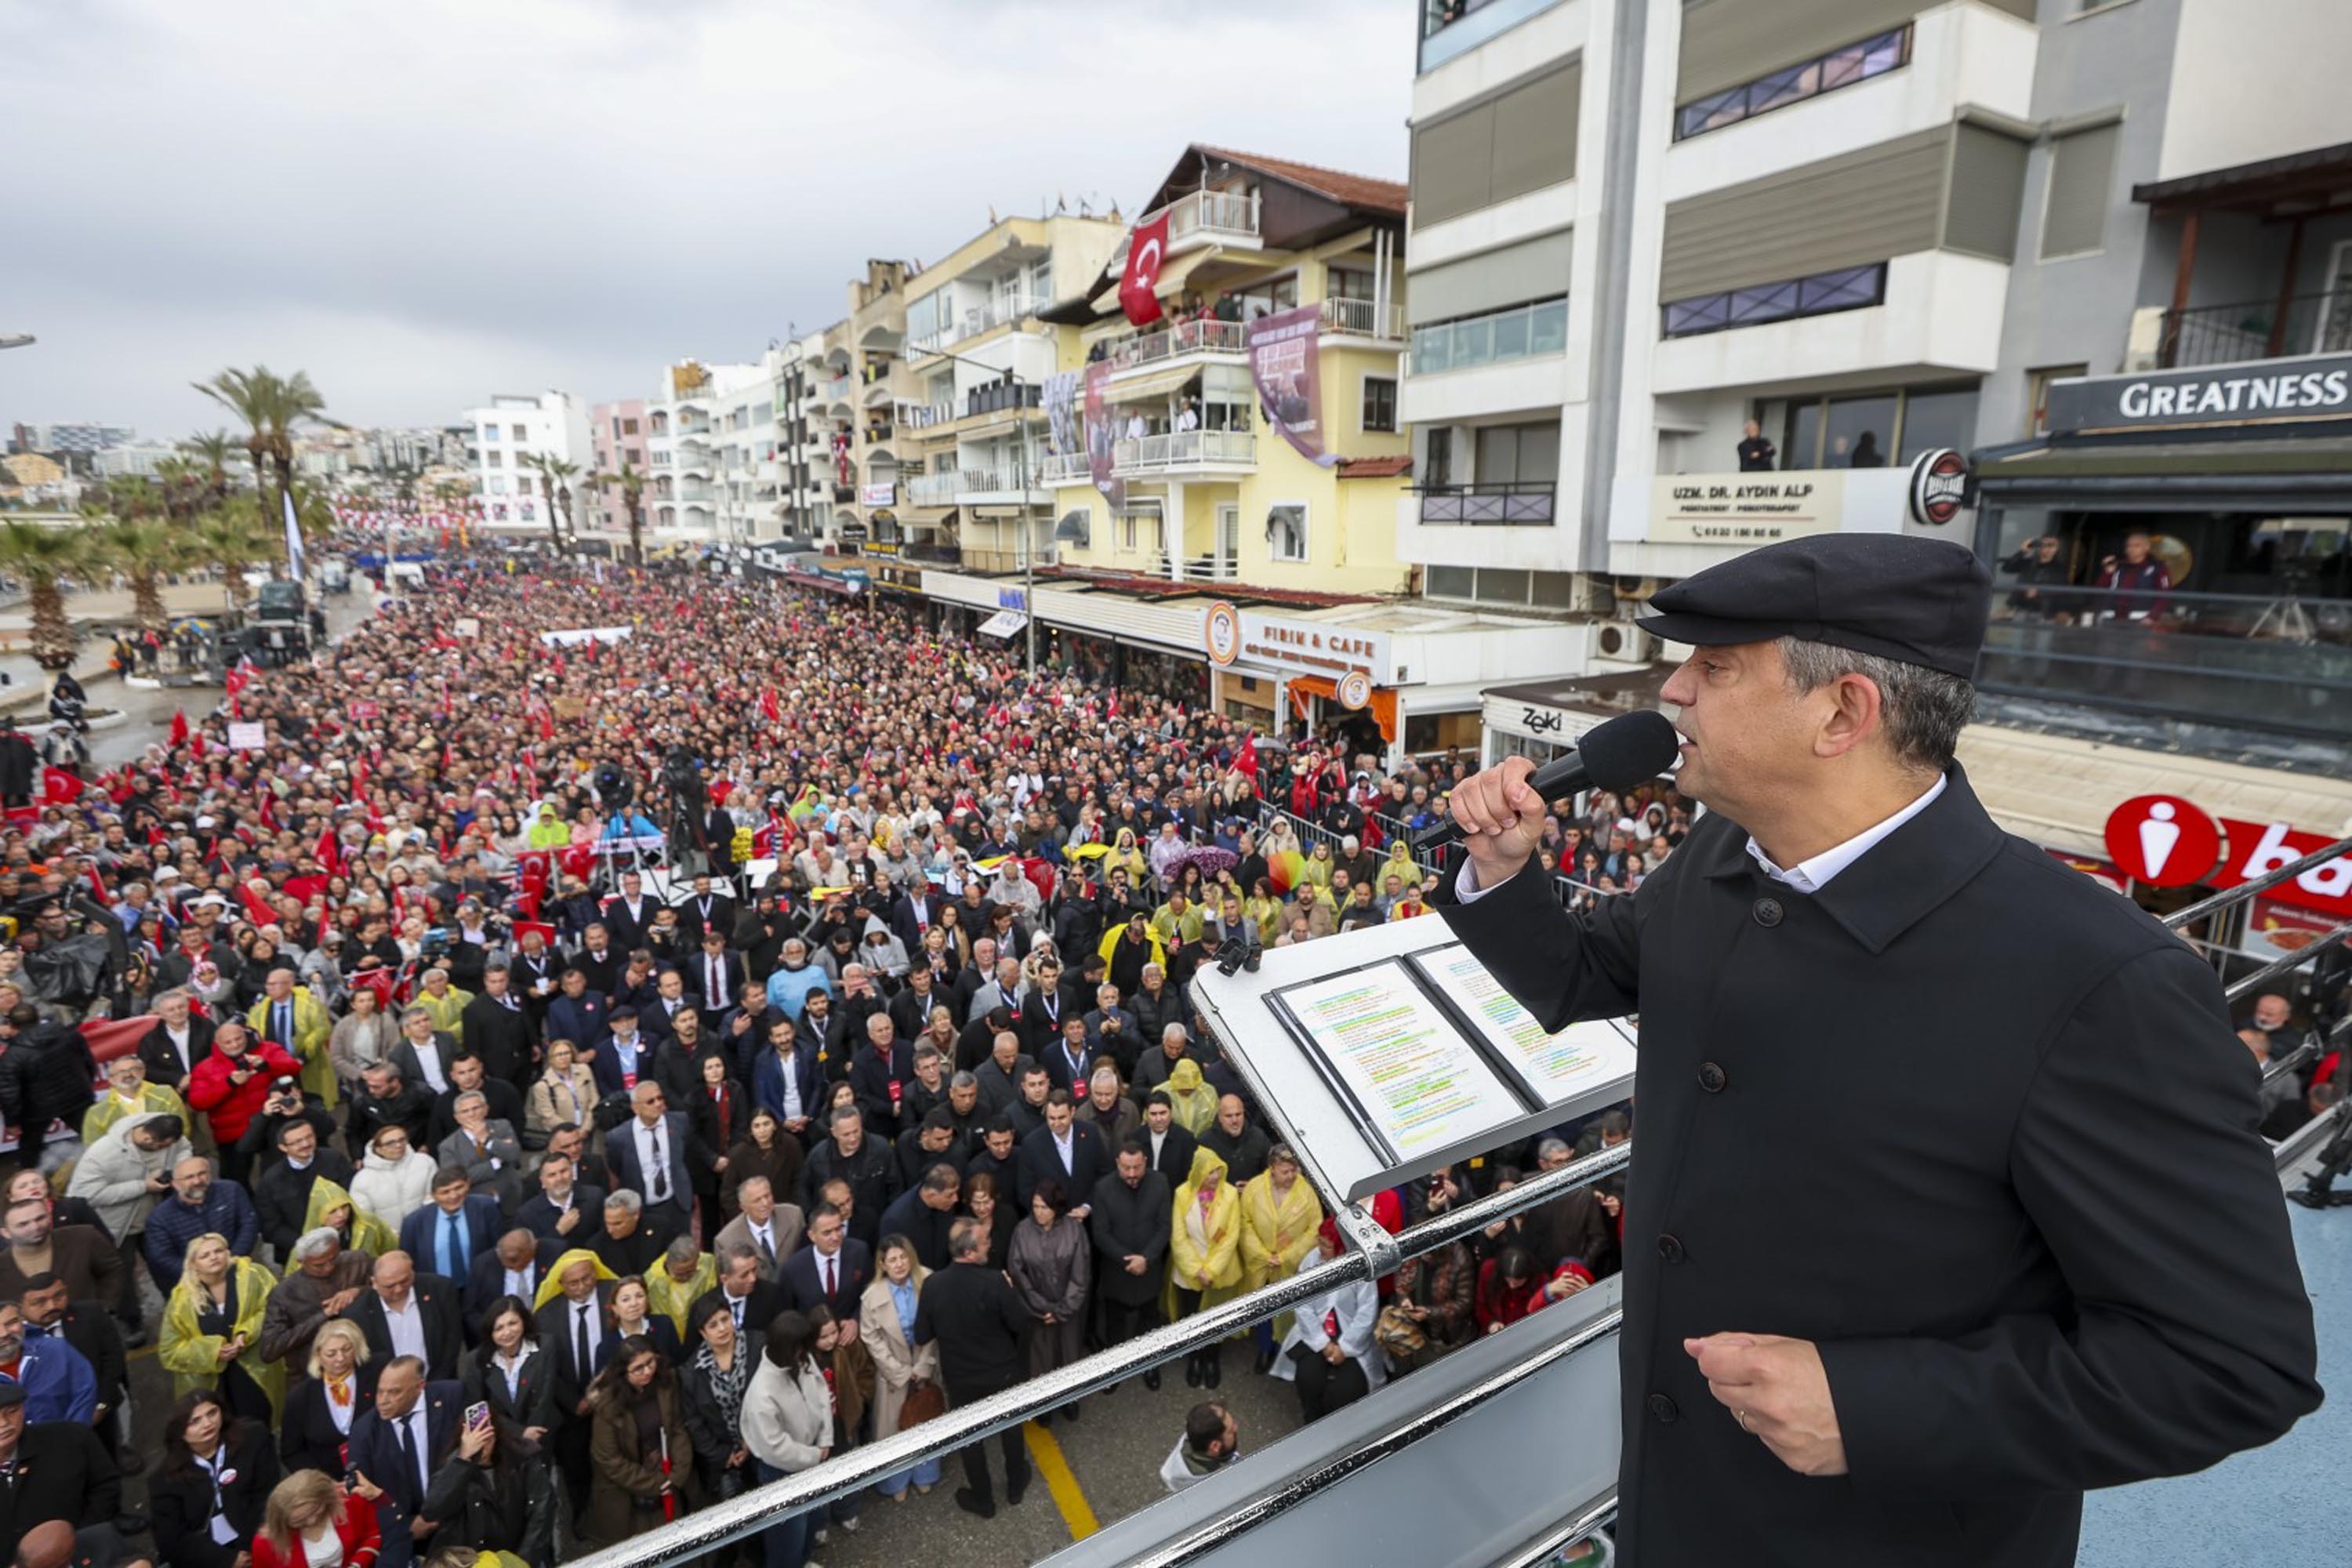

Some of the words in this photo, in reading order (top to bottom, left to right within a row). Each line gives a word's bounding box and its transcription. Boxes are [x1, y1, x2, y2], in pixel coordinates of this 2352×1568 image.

[2119, 370, 2348, 418] GREATNESS
[1673, 486, 1704, 499] UZM.
[1709, 486, 1731, 499] DR.
[1736, 485, 1780, 498] AYDIN
[1784, 484, 1813, 497] ALP
[1329, 636, 1375, 658] CAFE
[1522, 707, 1562, 734] Zeki
[2240, 823, 2352, 898] ba
